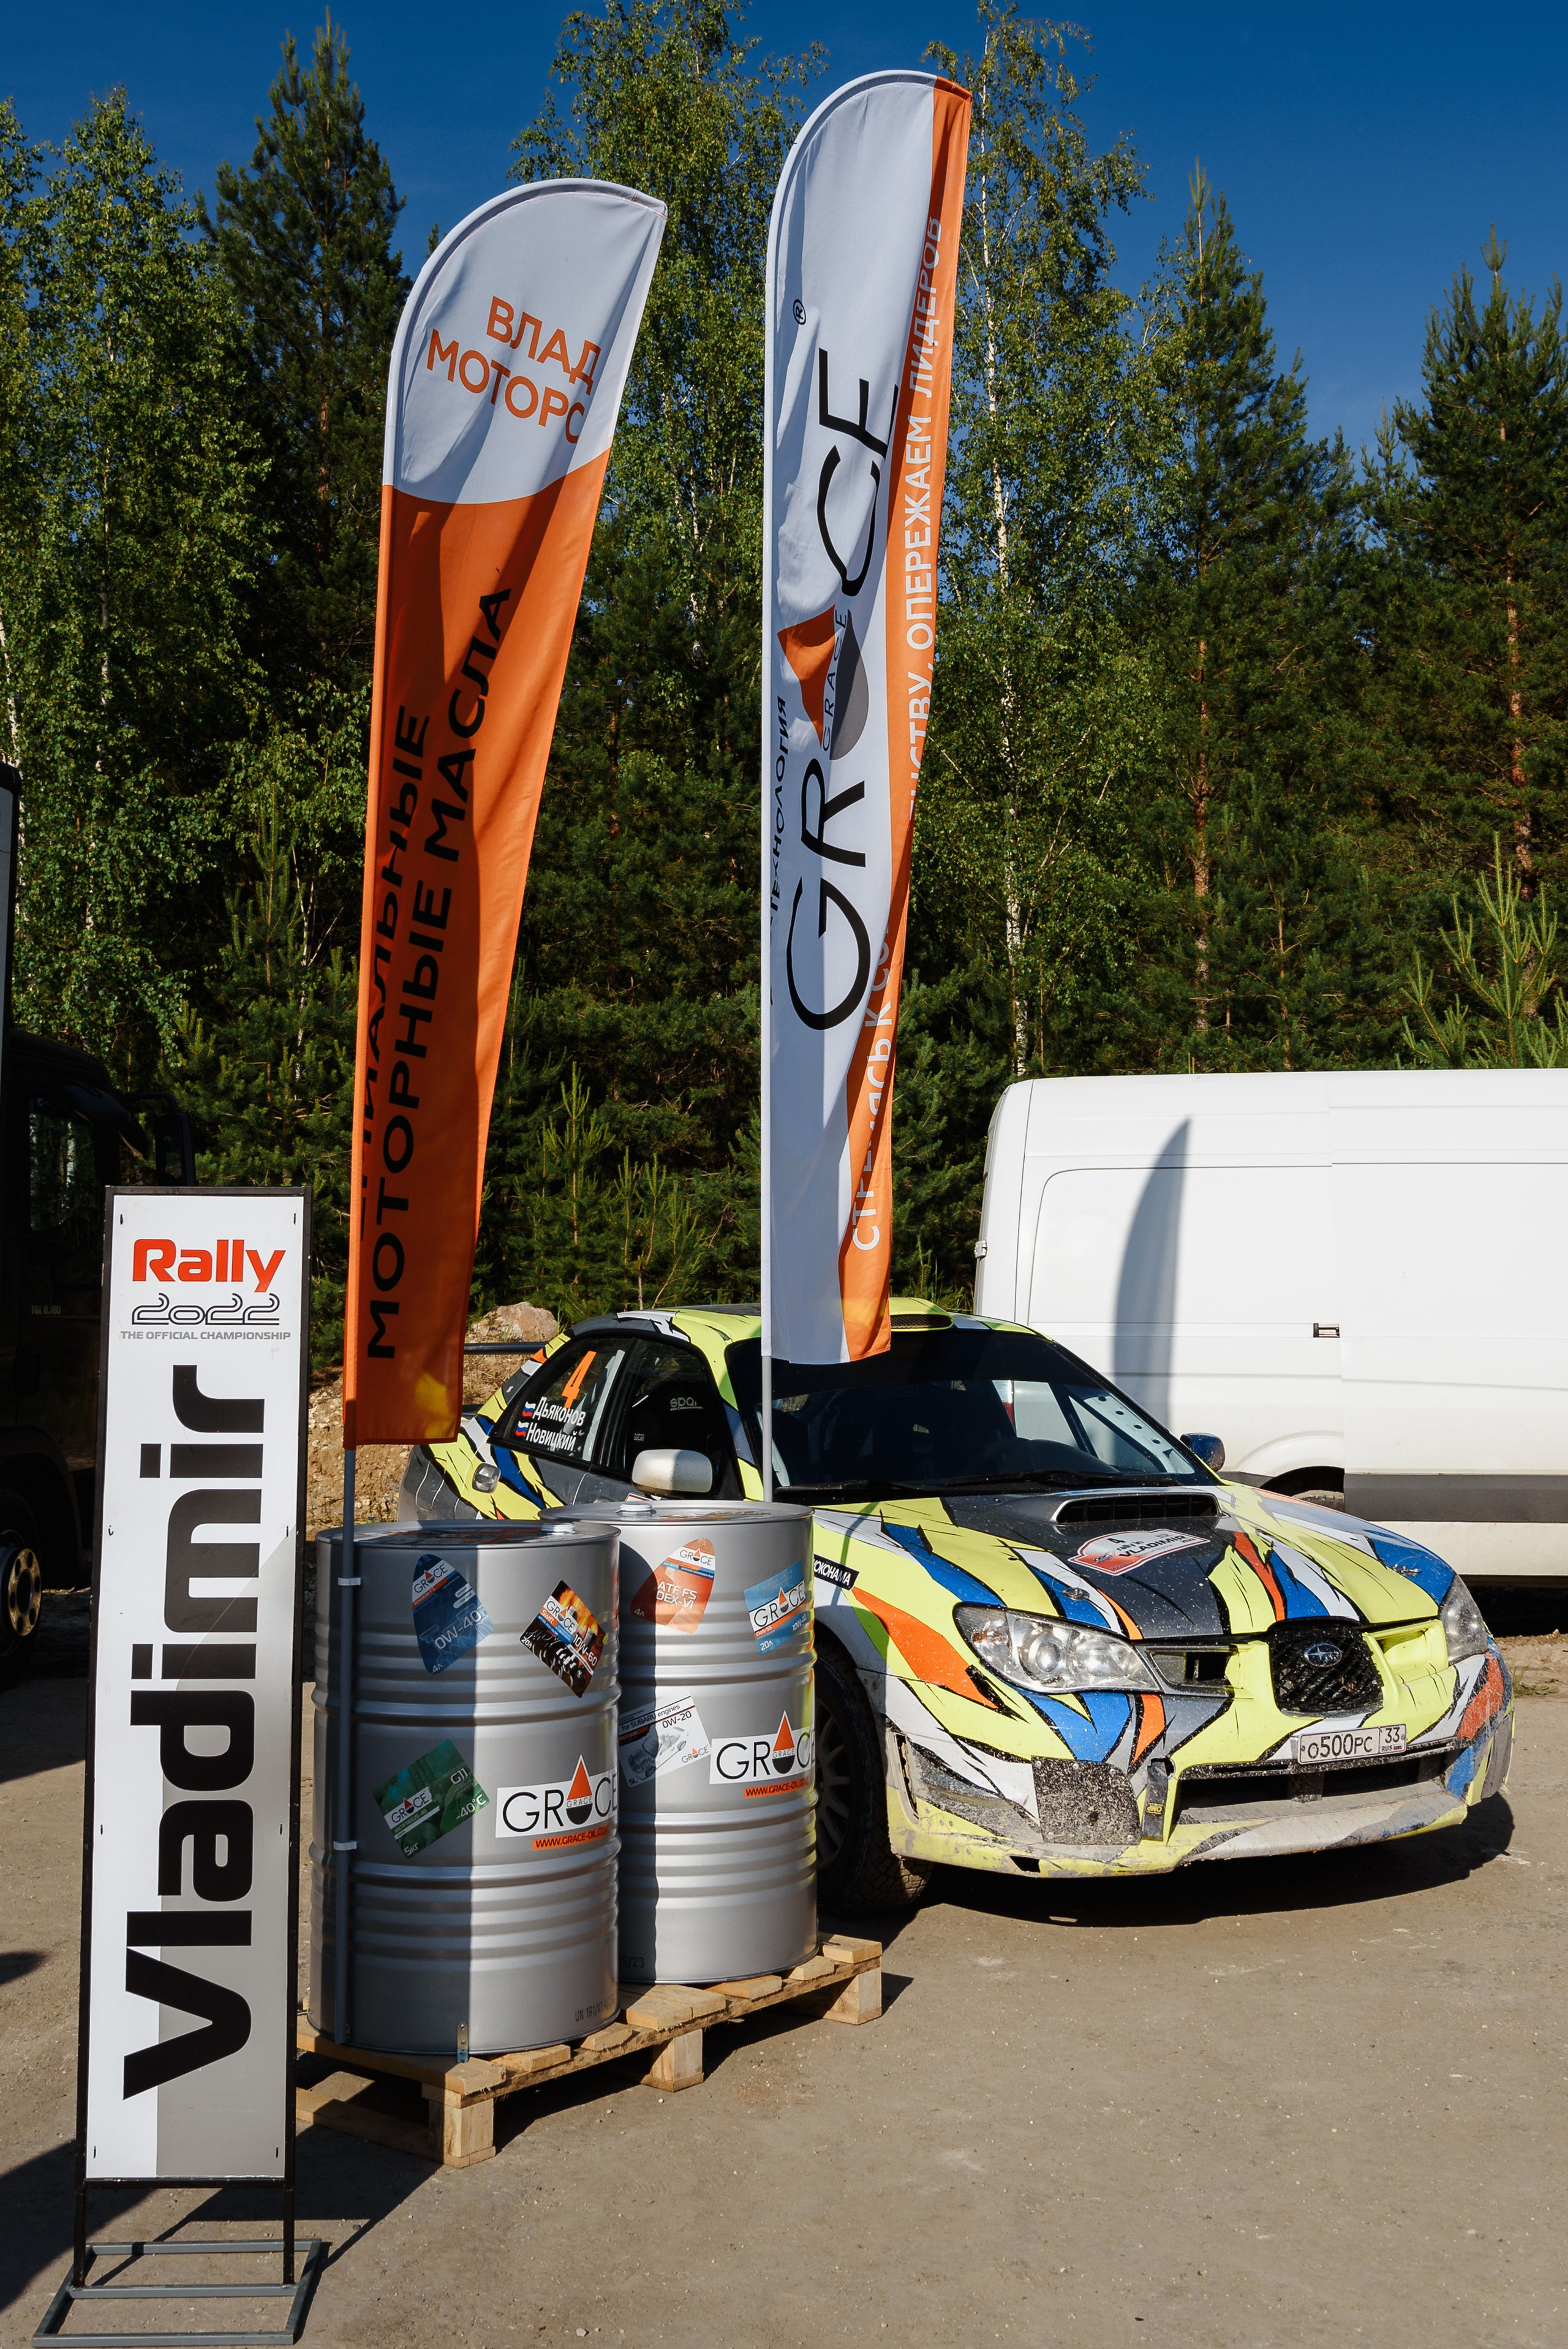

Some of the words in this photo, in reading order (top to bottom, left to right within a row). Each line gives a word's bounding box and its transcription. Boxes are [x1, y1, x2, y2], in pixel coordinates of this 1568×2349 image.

[909, 218, 942, 398] ЛИДЕРОВ
[487, 295, 601, 396] ВЛАД
[426, 328, 584, 444] МОТОРС
[903, 415, 934, 651] ОПЕРЕЖАЕМ
[368, 880, 452, 1360] МОТОРНЫЕ
[424, 588, 511, 863] МАСЛА
[865, 1000, 892, 1027] К
[132, 1239, 287, 1293] Rally
[132, 1292, 281, 1326] 2022
[120, 1331, 144, 1340] THE
[146, 1331, 198, 1341] OFFICIAL
[200, 1331, 292, 1341] CHAMPIONSHIP
[561, 1350, 597, 1409] 4
[670, 1397, 697, 1410] spa
[526, 1421, 577, 1452] Новицкий
[1117, 1542, 1137, 1551] rally
[1118, 1535, 1187, 1557] VLADIMIR
[656, 1590, 695, 1610] DEX-VI
[657, 1581, 681, 1594] ATF
[682, 1588, 698, 1600] FS
[435, 1610, 483, 1650] 0W-40
[573, 1633, 598, 1666] 10W-60
[630, 1713, 657, 1728] SUBARU
[657, 1704, 680, 1717] engines
[662, 1711, 692, 1728] 0W-20
[123, 1364, 265, 2100] Vladimir
[1385, 1727, 1400, 1744] 33
[772, 1748, 795, 1758] GRACE
[451, 1768, 468, 1784] G11
[566, 1796, 592, 1808] GRACE
